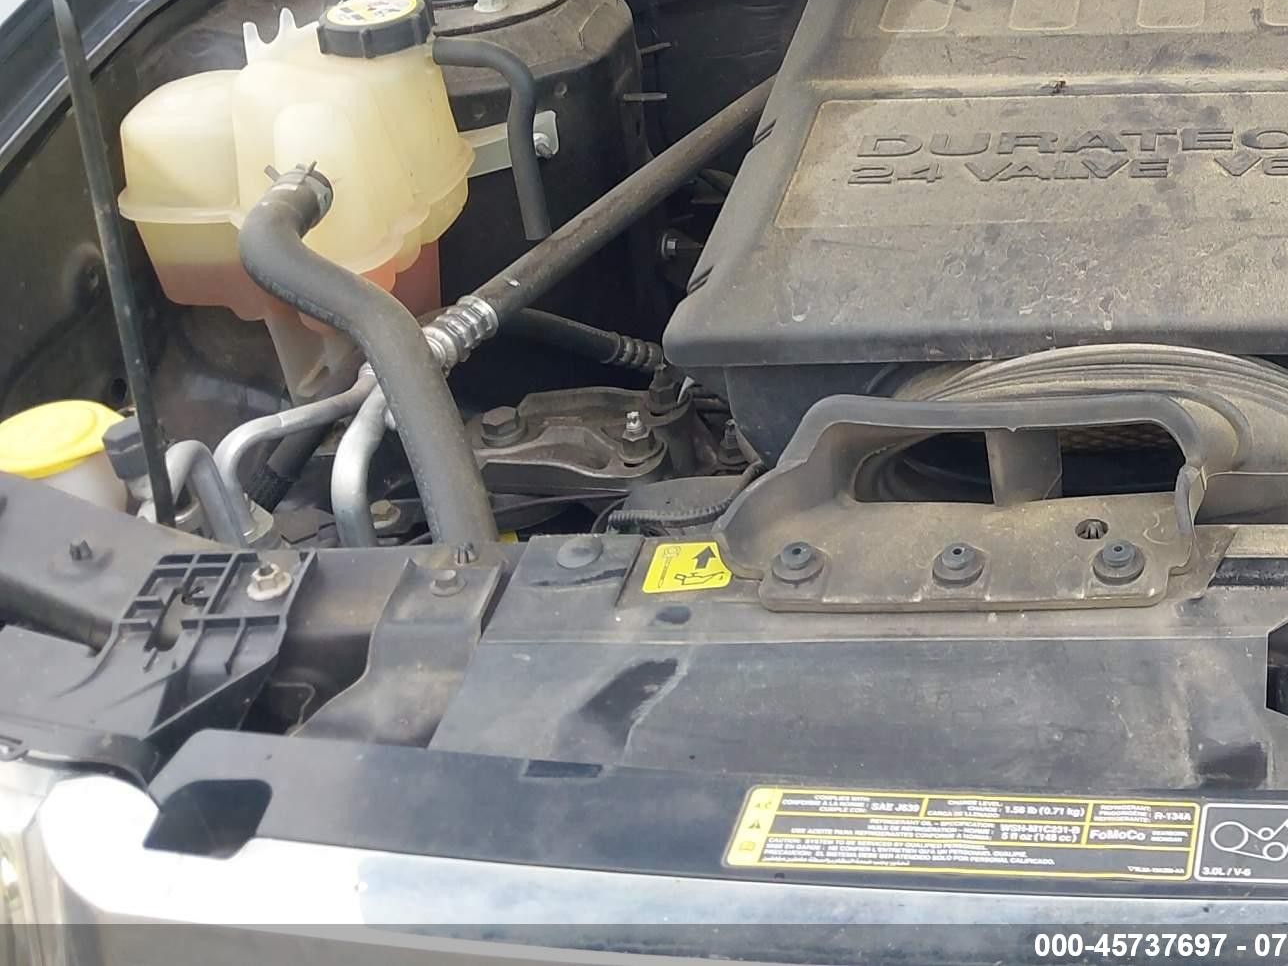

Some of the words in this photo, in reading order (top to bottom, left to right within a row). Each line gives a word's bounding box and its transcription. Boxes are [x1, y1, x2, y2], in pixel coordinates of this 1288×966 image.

[848, 161, 944, 184] 24
[964, 158, 1170, 182] VALVE
[871, 802, 894, 811] SAE
[895, 804, 920, 812] J639
[1027, 806, 1037, 814] lb
[1039, 807, 1064, 816] (0.71
[1067, 808, 1085, 817] kg)
[1154, 812, 1192, 821] R-134A
[1089, 829, 1146, 840] FoMoCo
[1201, 867, 1225, 876] 3.0L
[1234, 868, 1251, 876] V-6
